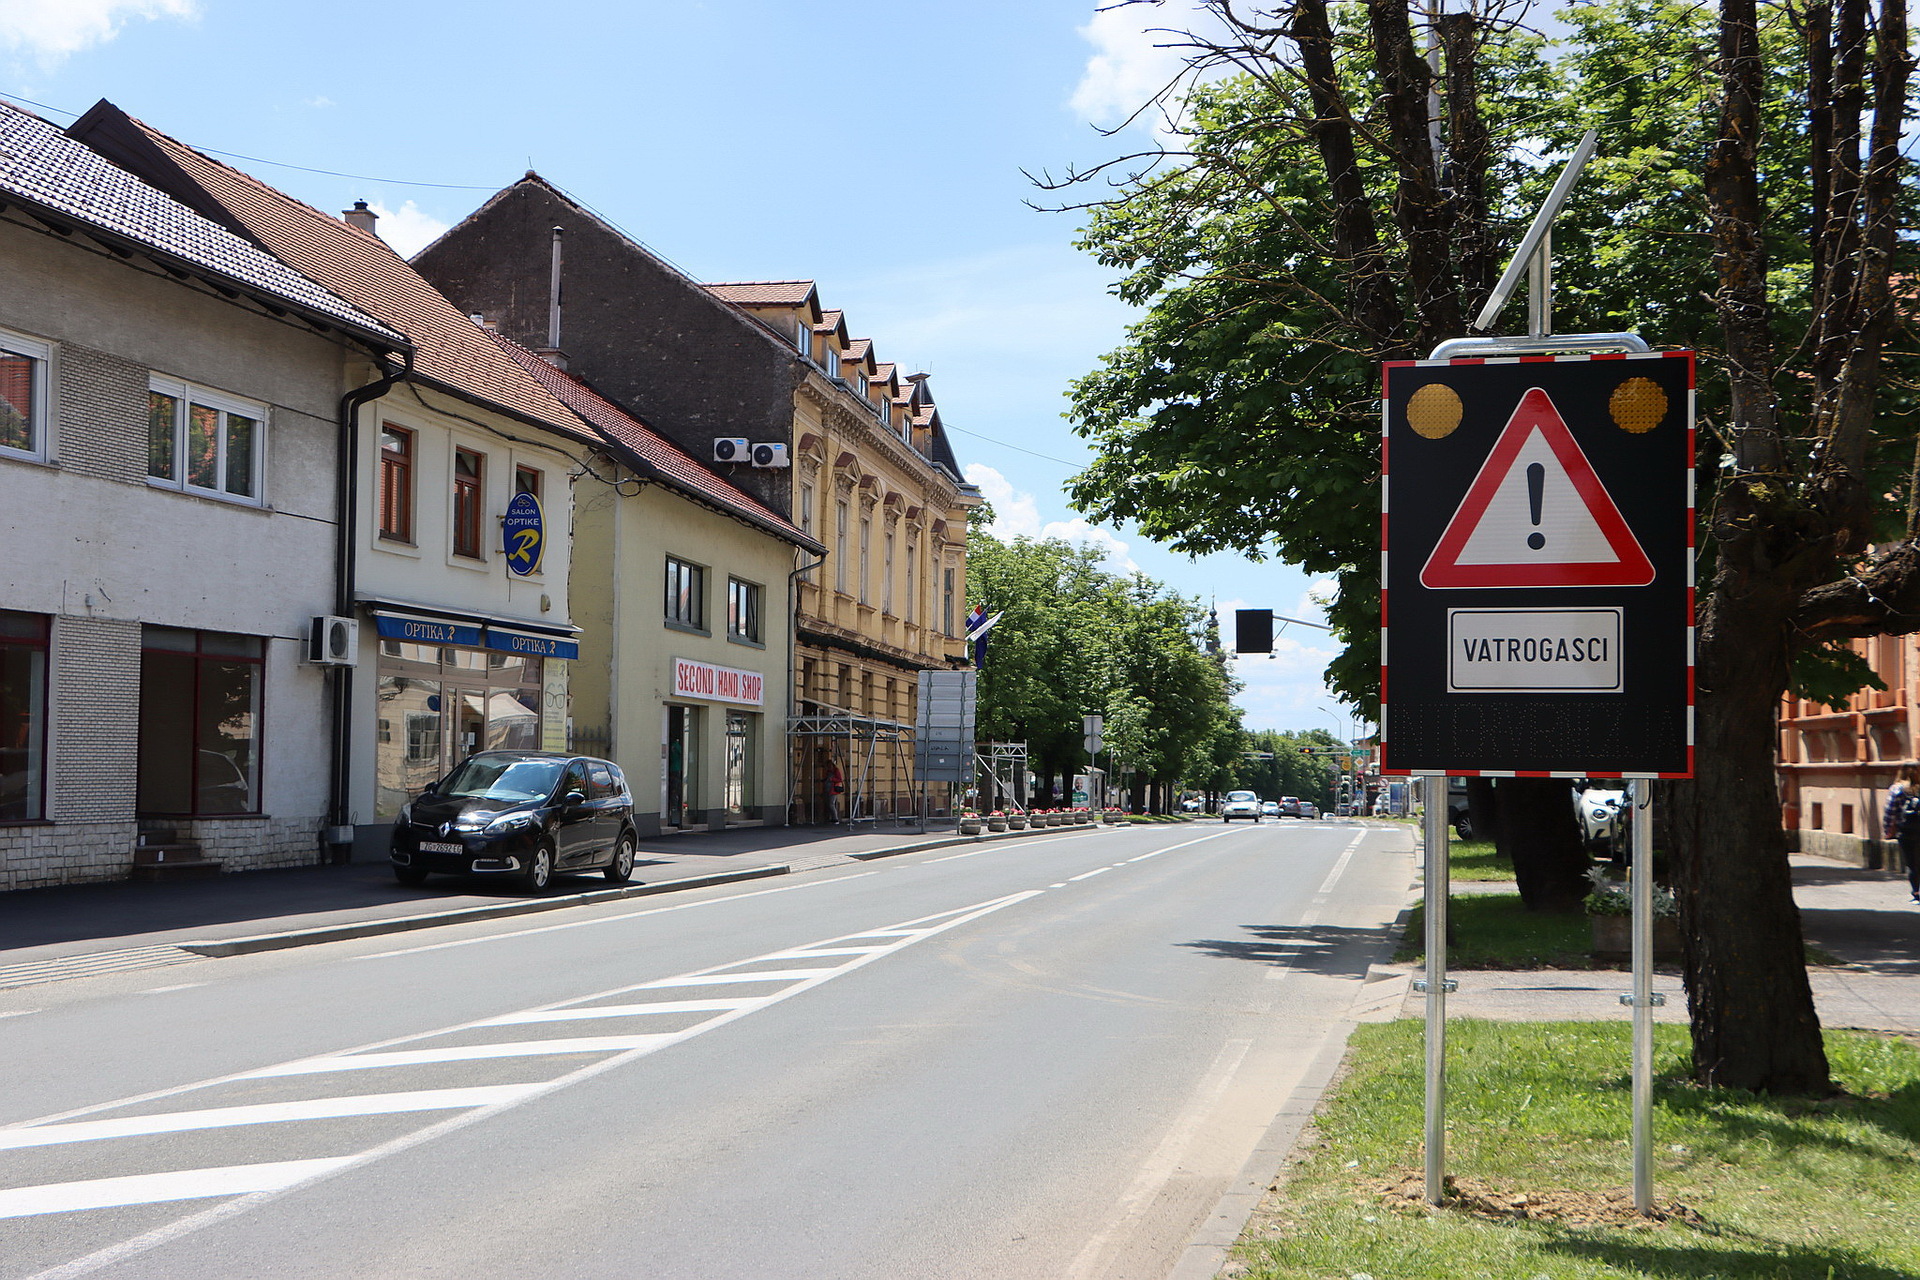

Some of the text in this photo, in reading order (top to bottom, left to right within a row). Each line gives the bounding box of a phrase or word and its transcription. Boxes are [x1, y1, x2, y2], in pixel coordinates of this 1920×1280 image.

[507, 518, 540, 526] OPTIKE
[404, 622, 444, 640] OPTIKA
[512, 636, 547, 654] OPTIKA
[1463, 637, 1608, 663] VATROGASCI
[678, 662, 762, 701] SECOND HAND SHOP
